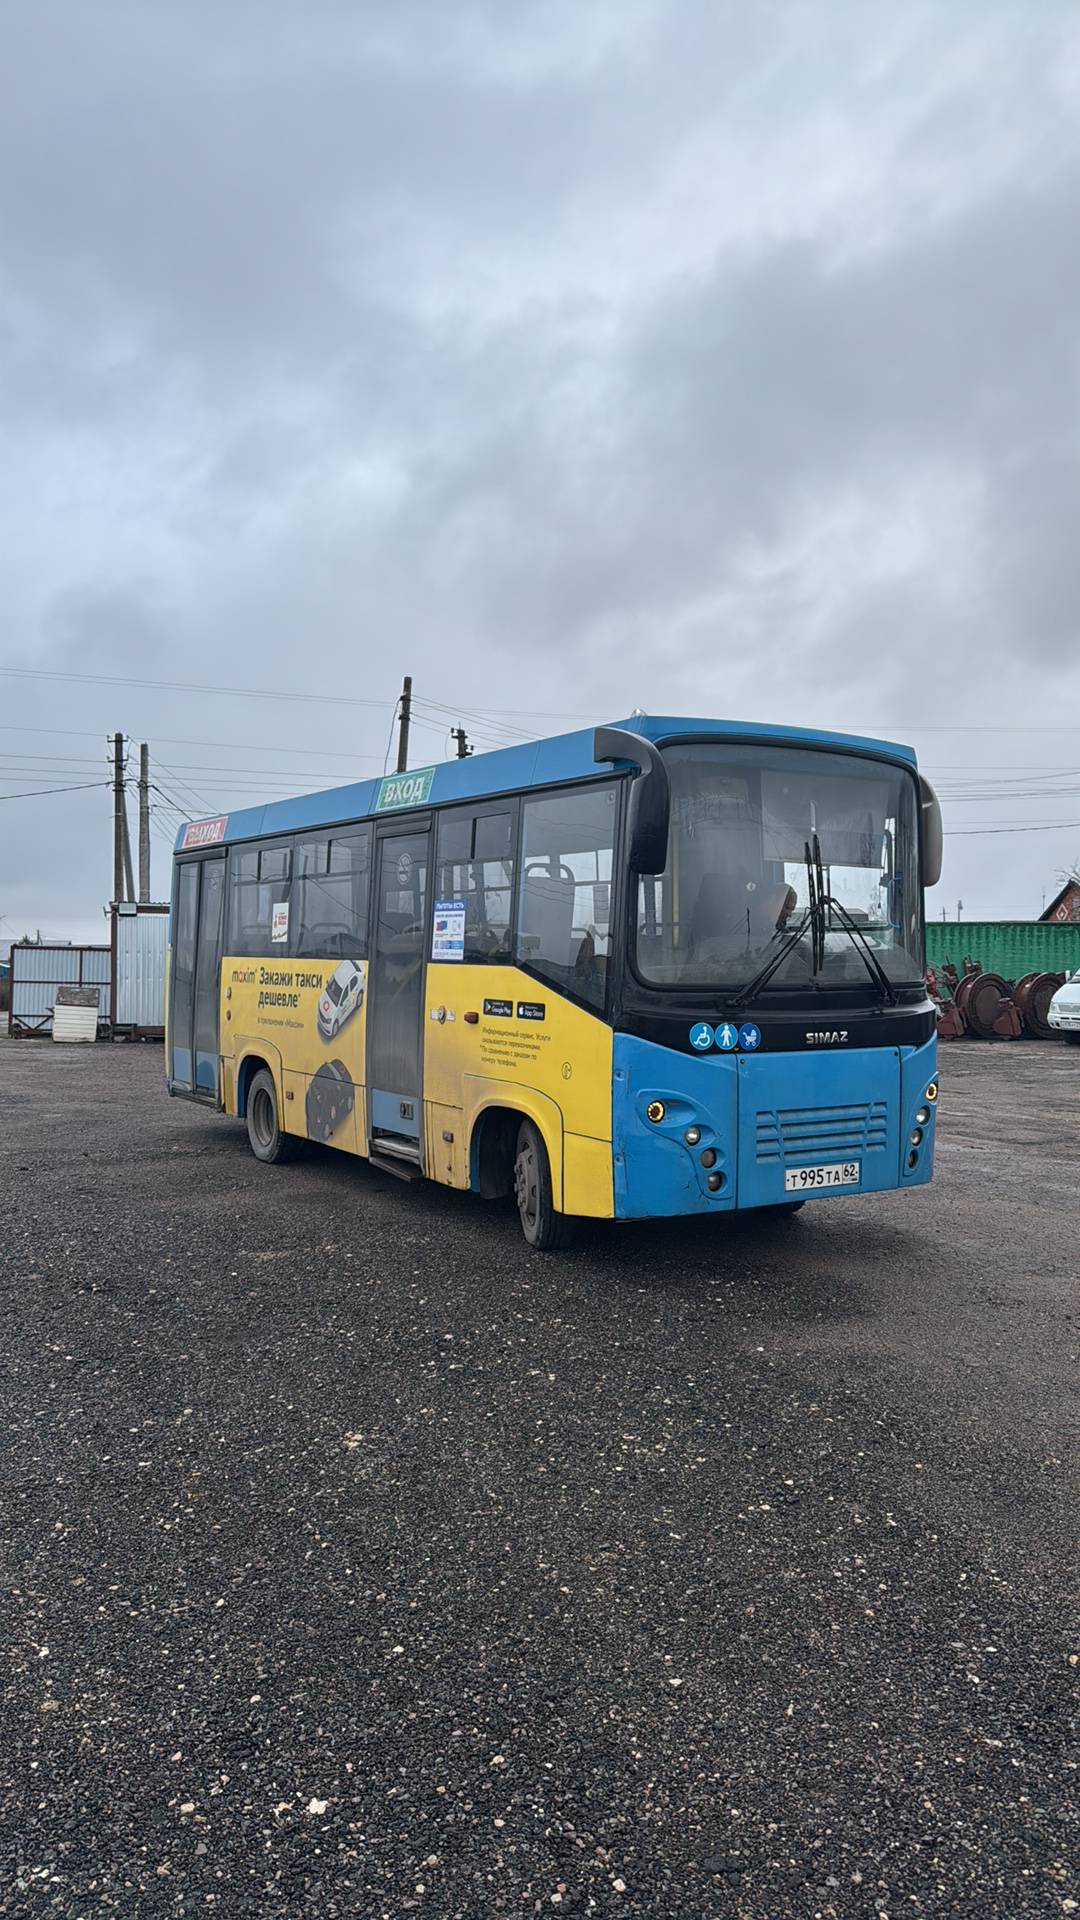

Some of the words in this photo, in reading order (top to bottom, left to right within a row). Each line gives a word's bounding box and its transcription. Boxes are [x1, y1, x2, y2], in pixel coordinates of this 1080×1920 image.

[384, 777, 425, 802] ВХОД
[259, 966, 293, 986] Закажи
[295, 973, 323, 989] такси
[805, 1031, 849, 1045] SIMAZ
